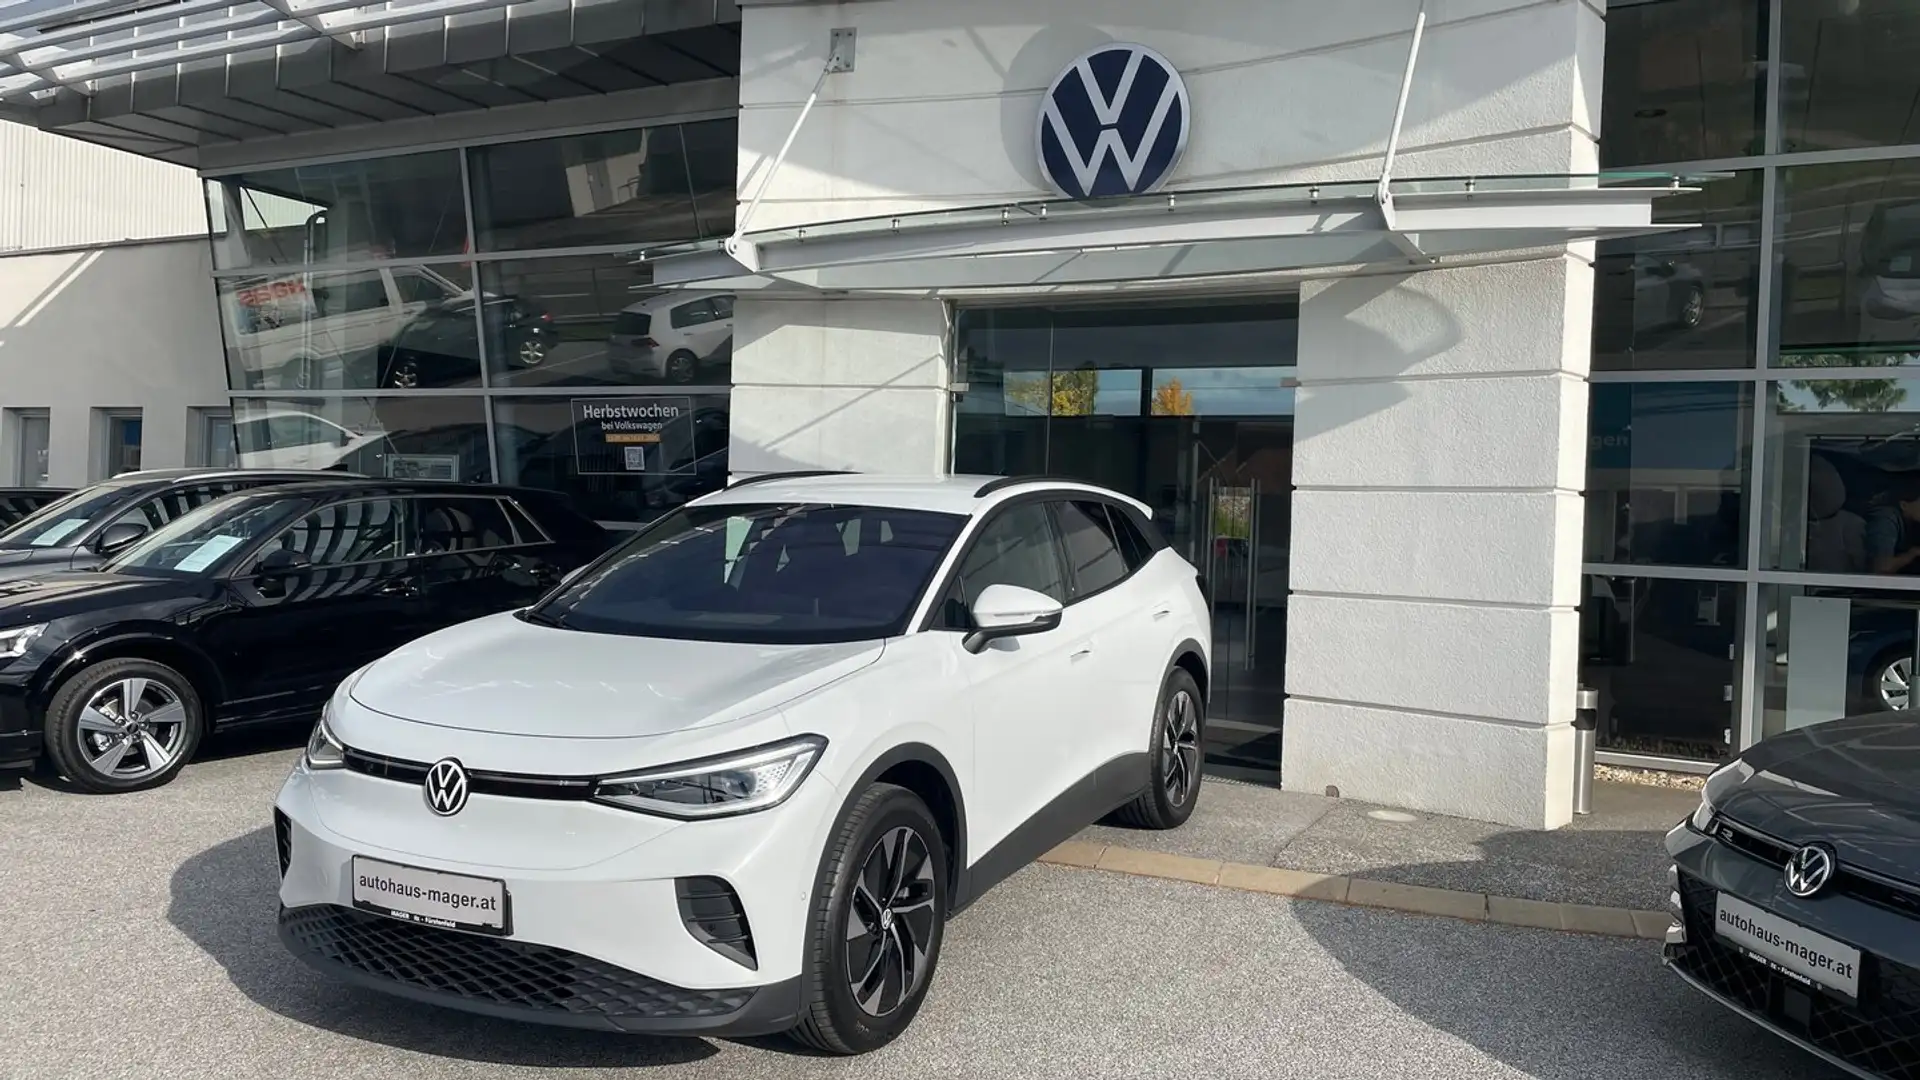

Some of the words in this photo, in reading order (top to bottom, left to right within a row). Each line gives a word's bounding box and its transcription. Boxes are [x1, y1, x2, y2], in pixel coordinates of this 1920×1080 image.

[583, 404, 678, 418] Herbstwochen
[601, 421, 613, 430] bei
[614, 421, 663, 432] Volkswagen
[359, 875, 496, 911] autohaus-mager.at
[1719, 908, 1853, 979] autohaus-mager.at
